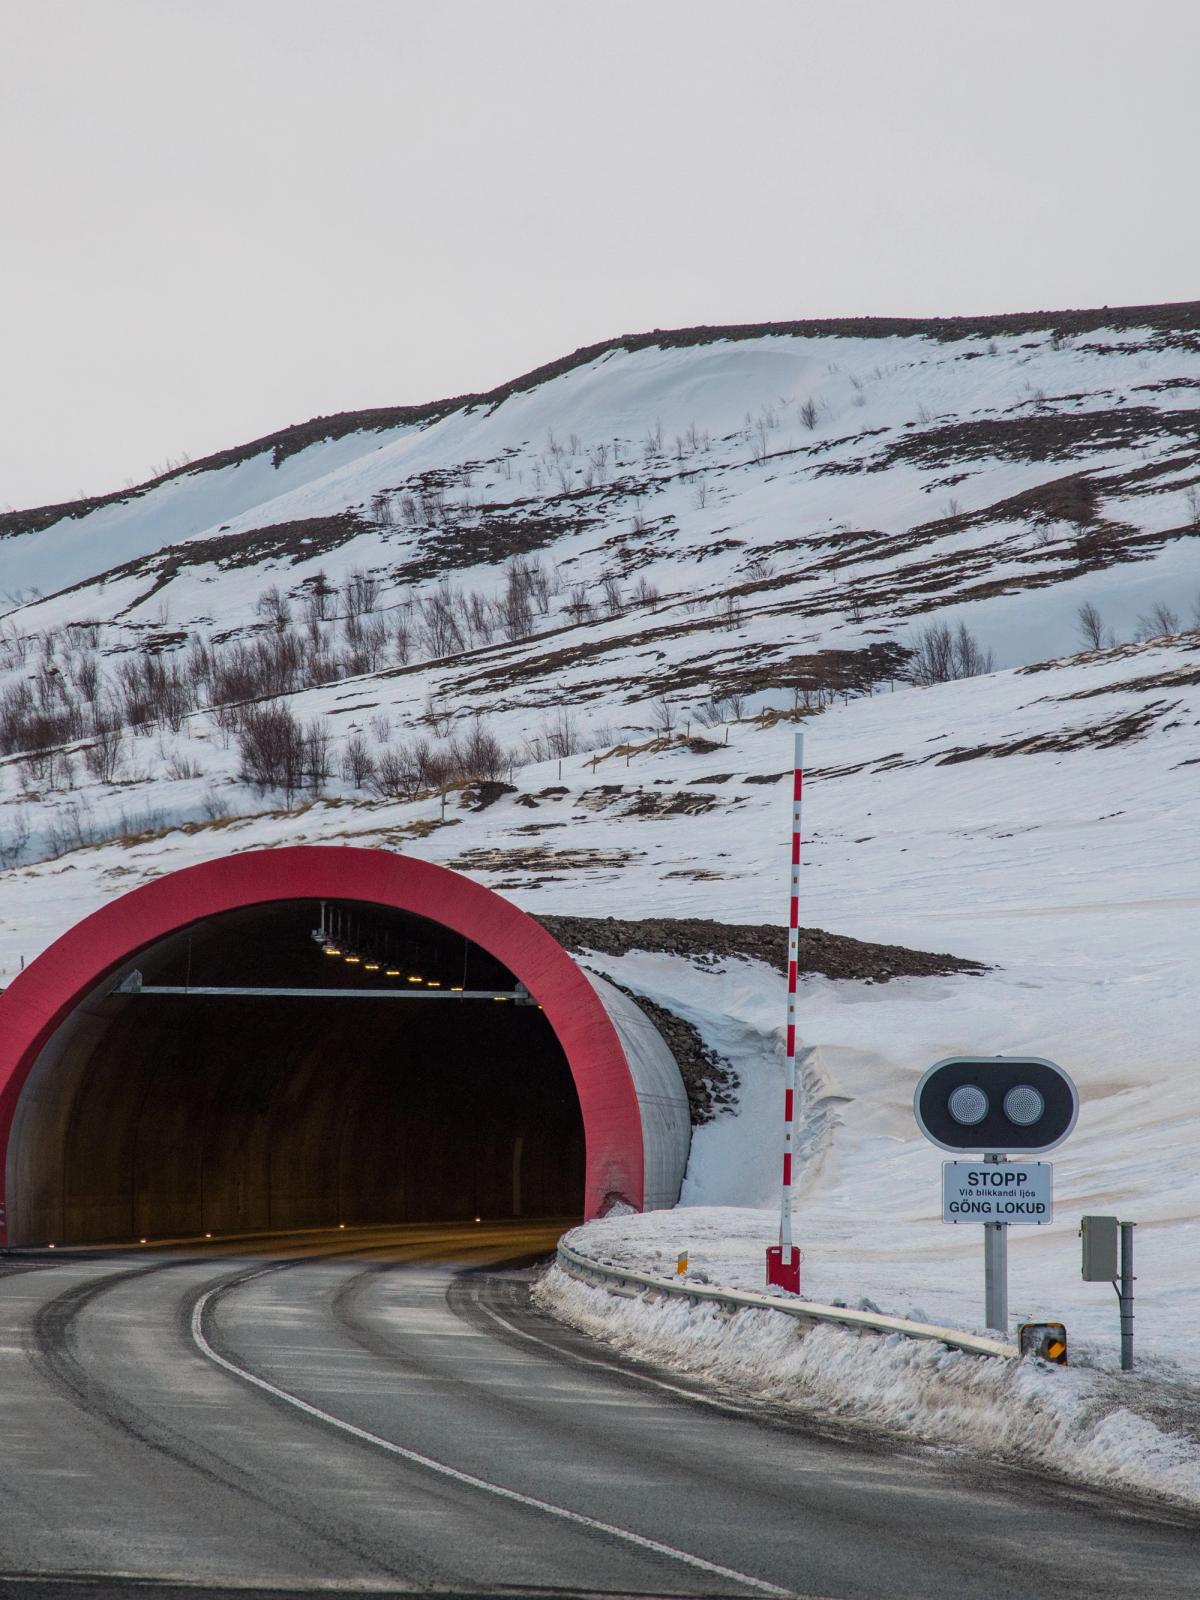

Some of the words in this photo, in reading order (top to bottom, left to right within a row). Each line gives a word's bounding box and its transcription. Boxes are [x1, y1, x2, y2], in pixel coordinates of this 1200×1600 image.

[968, 1172, 1027, 1186] STOPP
[976, 1189, 1017, 1197] blikkandi
[1019, 1189, 1036, 1198] ljós
[949, 1199, 991, 1213] GÖNG
[997, 1202, 1045, 1213] LOKUÐ
